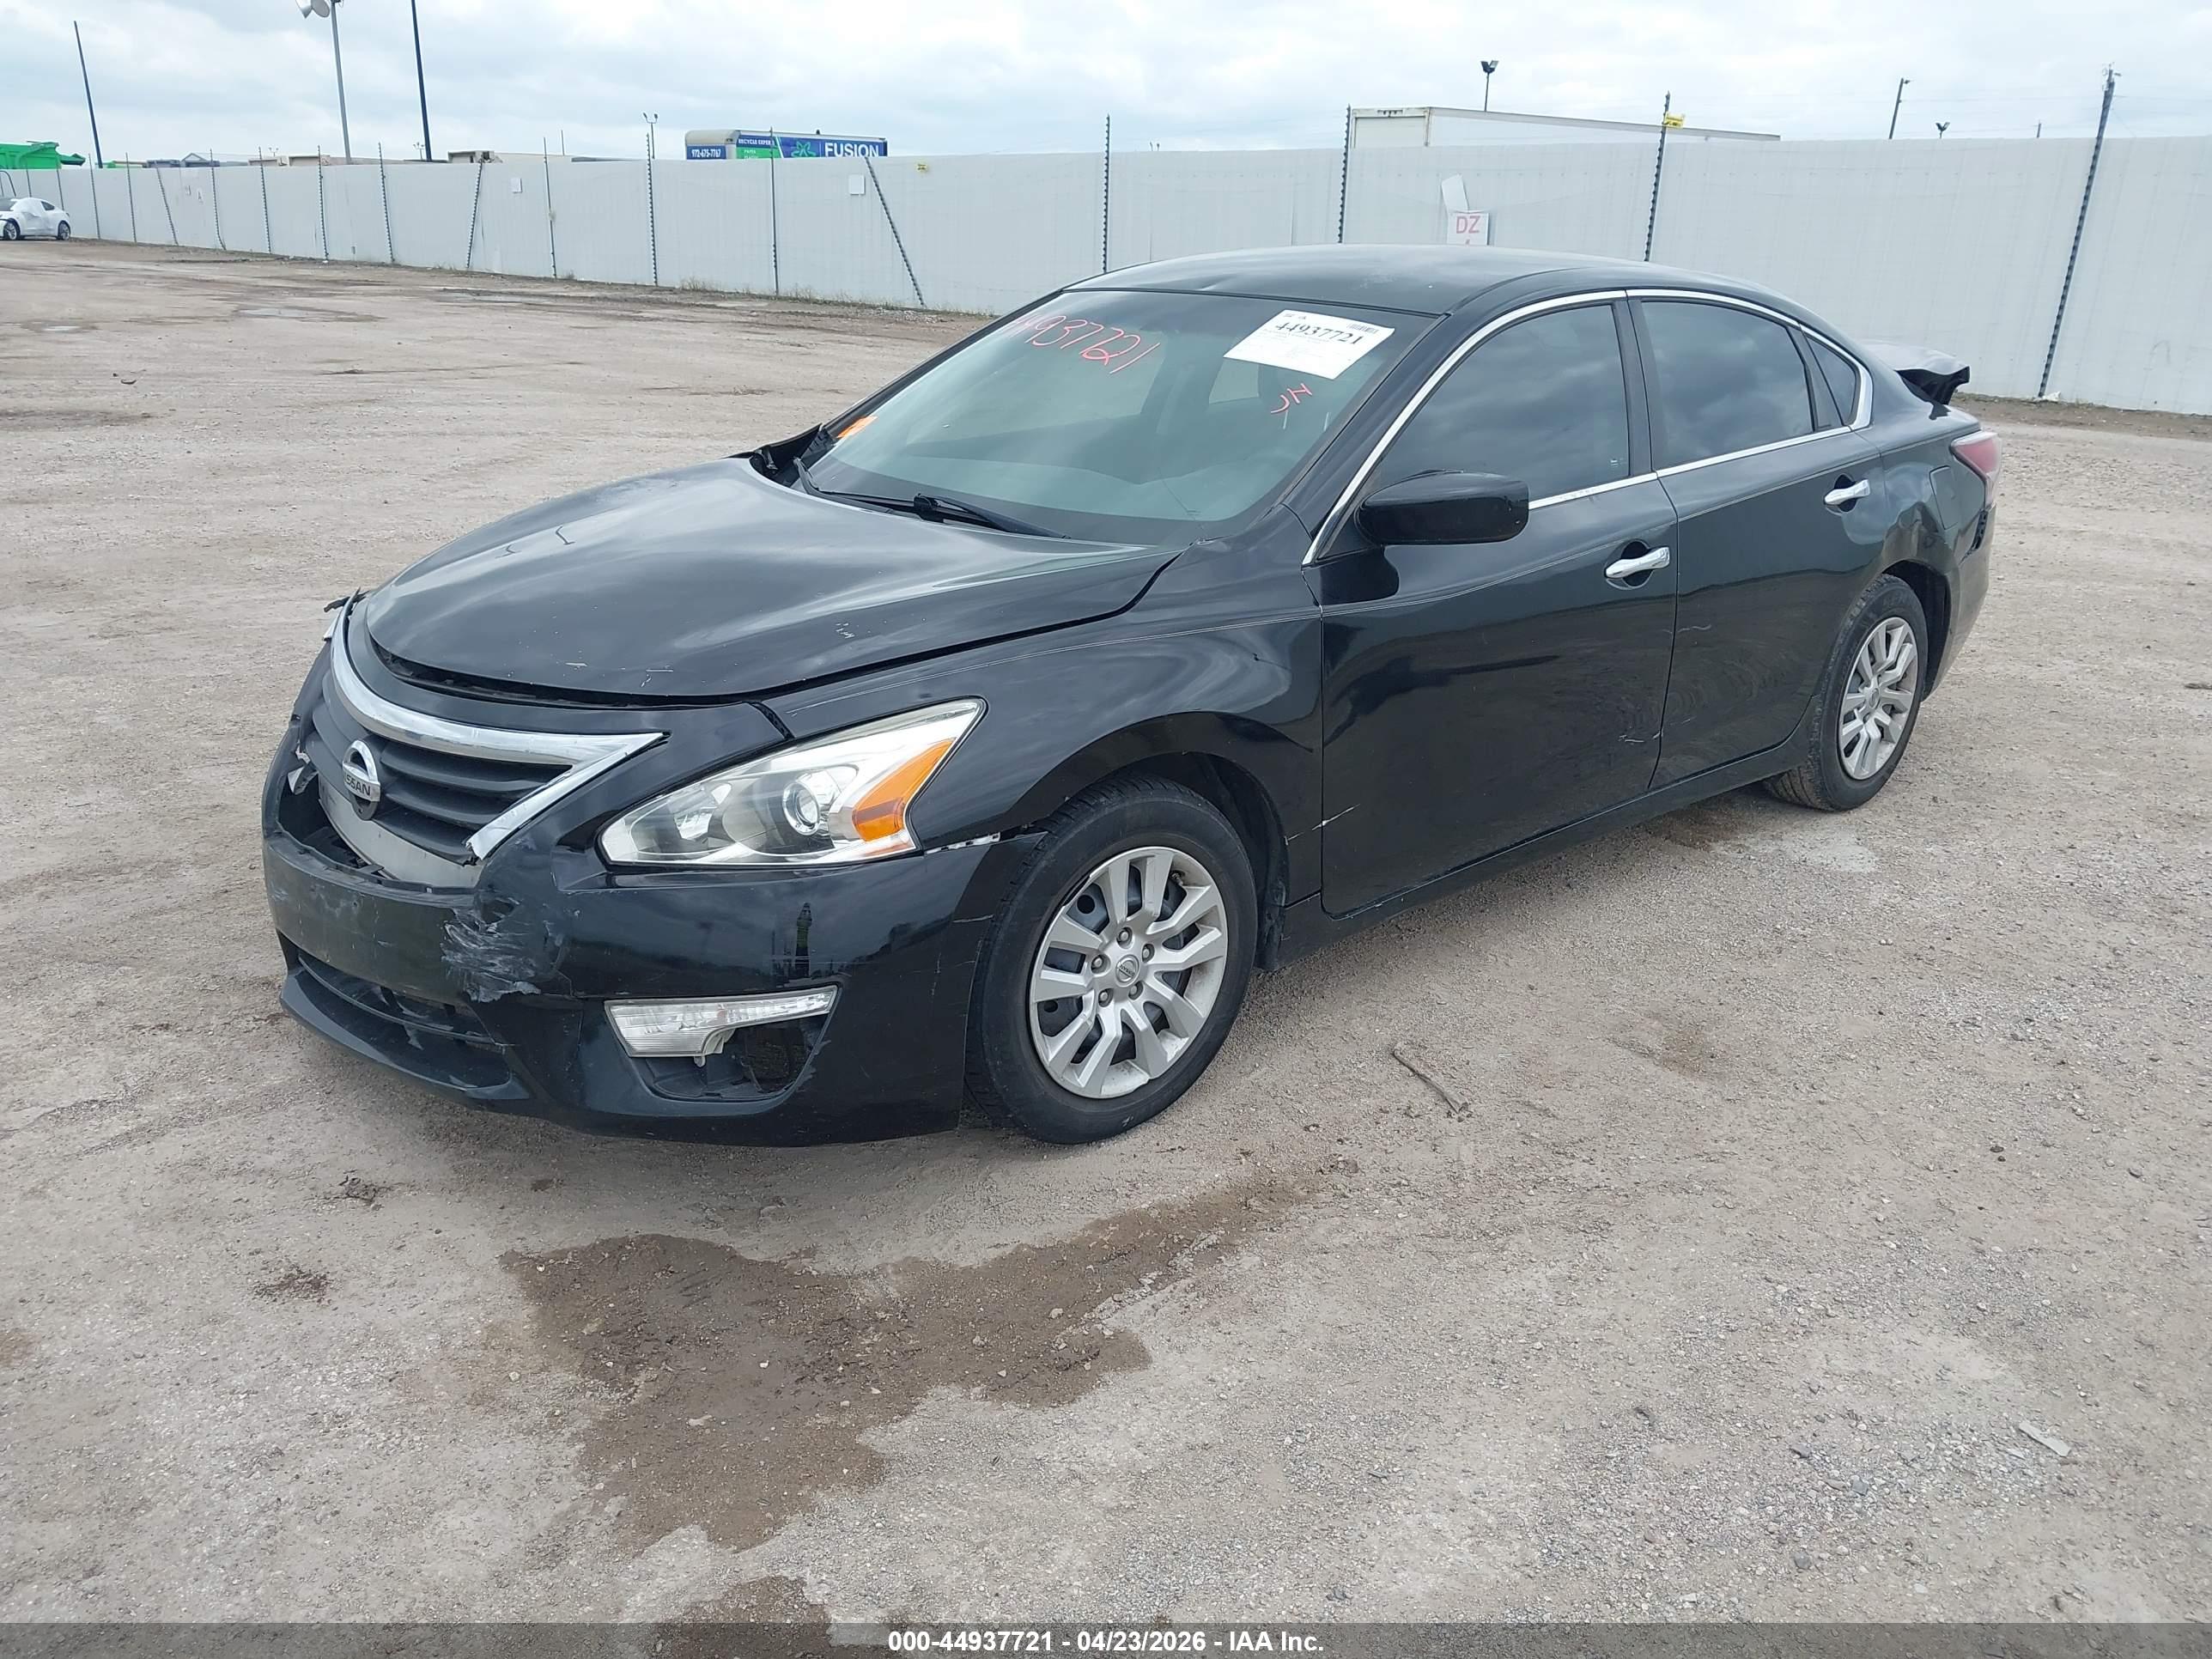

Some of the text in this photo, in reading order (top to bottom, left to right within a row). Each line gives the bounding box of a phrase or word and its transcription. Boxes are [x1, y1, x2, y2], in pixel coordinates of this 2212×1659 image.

[825, 142, 879, 158] FUSION
[1455, 215, 1480, 234] DZ
[1274, 322, 1364, 344] 44937721
